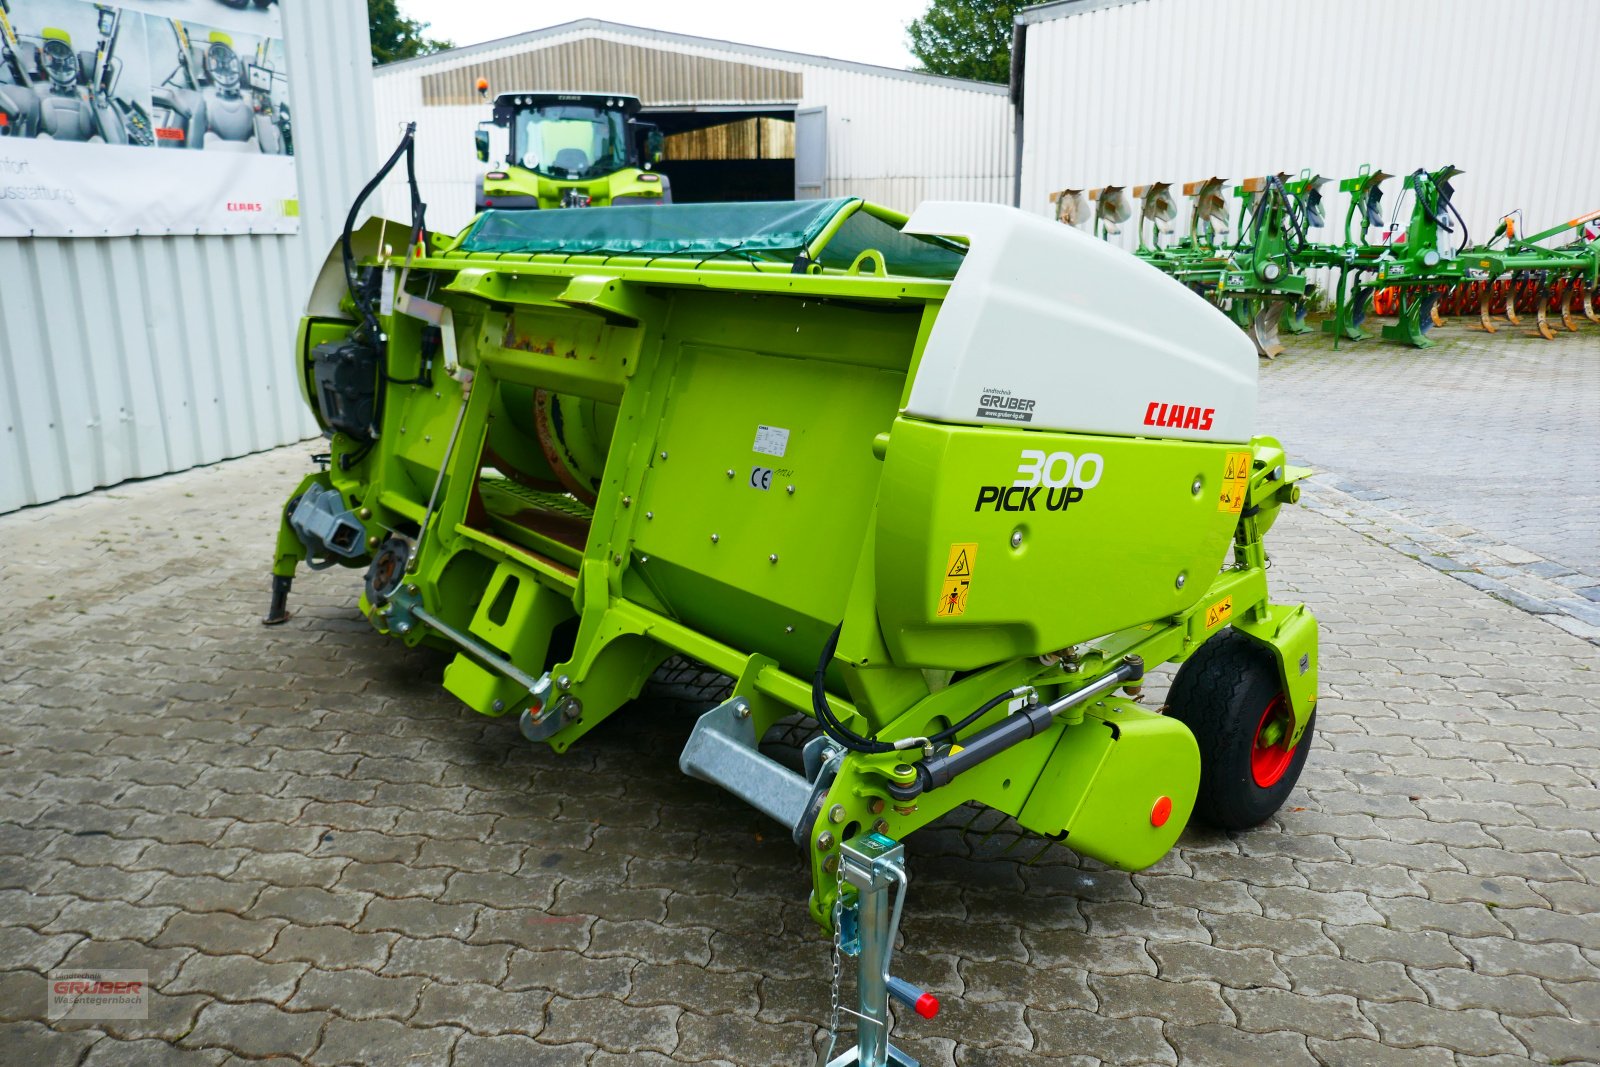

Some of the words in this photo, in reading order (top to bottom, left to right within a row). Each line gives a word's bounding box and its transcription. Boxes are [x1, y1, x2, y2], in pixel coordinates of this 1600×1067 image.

[227, 202, 262, 212] CLAAS
[980, 394, 1036, 411] GRUBER
[1143, 401, 1215, 431] CLAAS
[1012, 449, 1104, 490] 300
[974, 486, 1043, 512] PICK
[1047, 487, 1084, 511] UP
